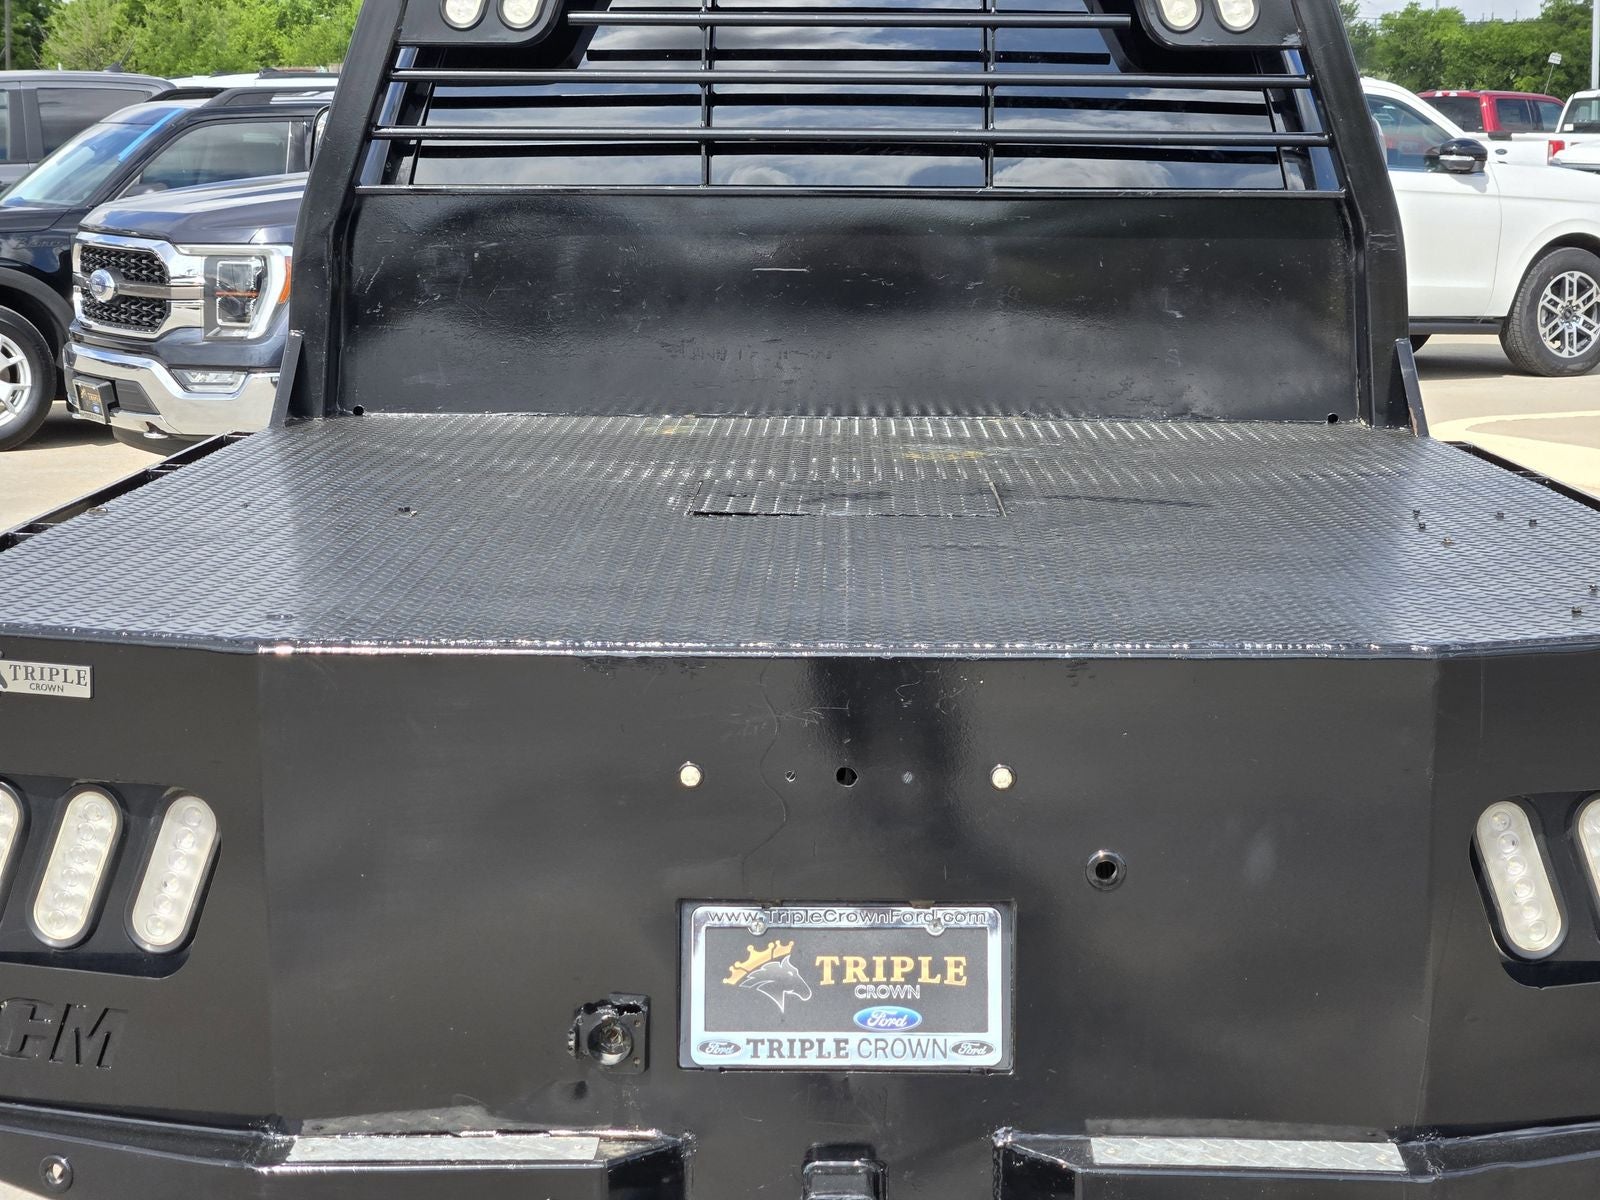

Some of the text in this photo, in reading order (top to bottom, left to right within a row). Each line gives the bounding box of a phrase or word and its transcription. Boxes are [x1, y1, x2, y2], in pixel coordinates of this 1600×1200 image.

[8, 664, 88, 687] TRIPLE
[29, 682, 64, 693] CROWN
[814, 955, 968, 986] TRIPLE
[854, 984, 921, 999] CROWN
[866, 1009, 908, 1028] Ford
[746, 1038, 849, 1059] TRIPLE
[857, 1038, 948, 1059] CROWN
